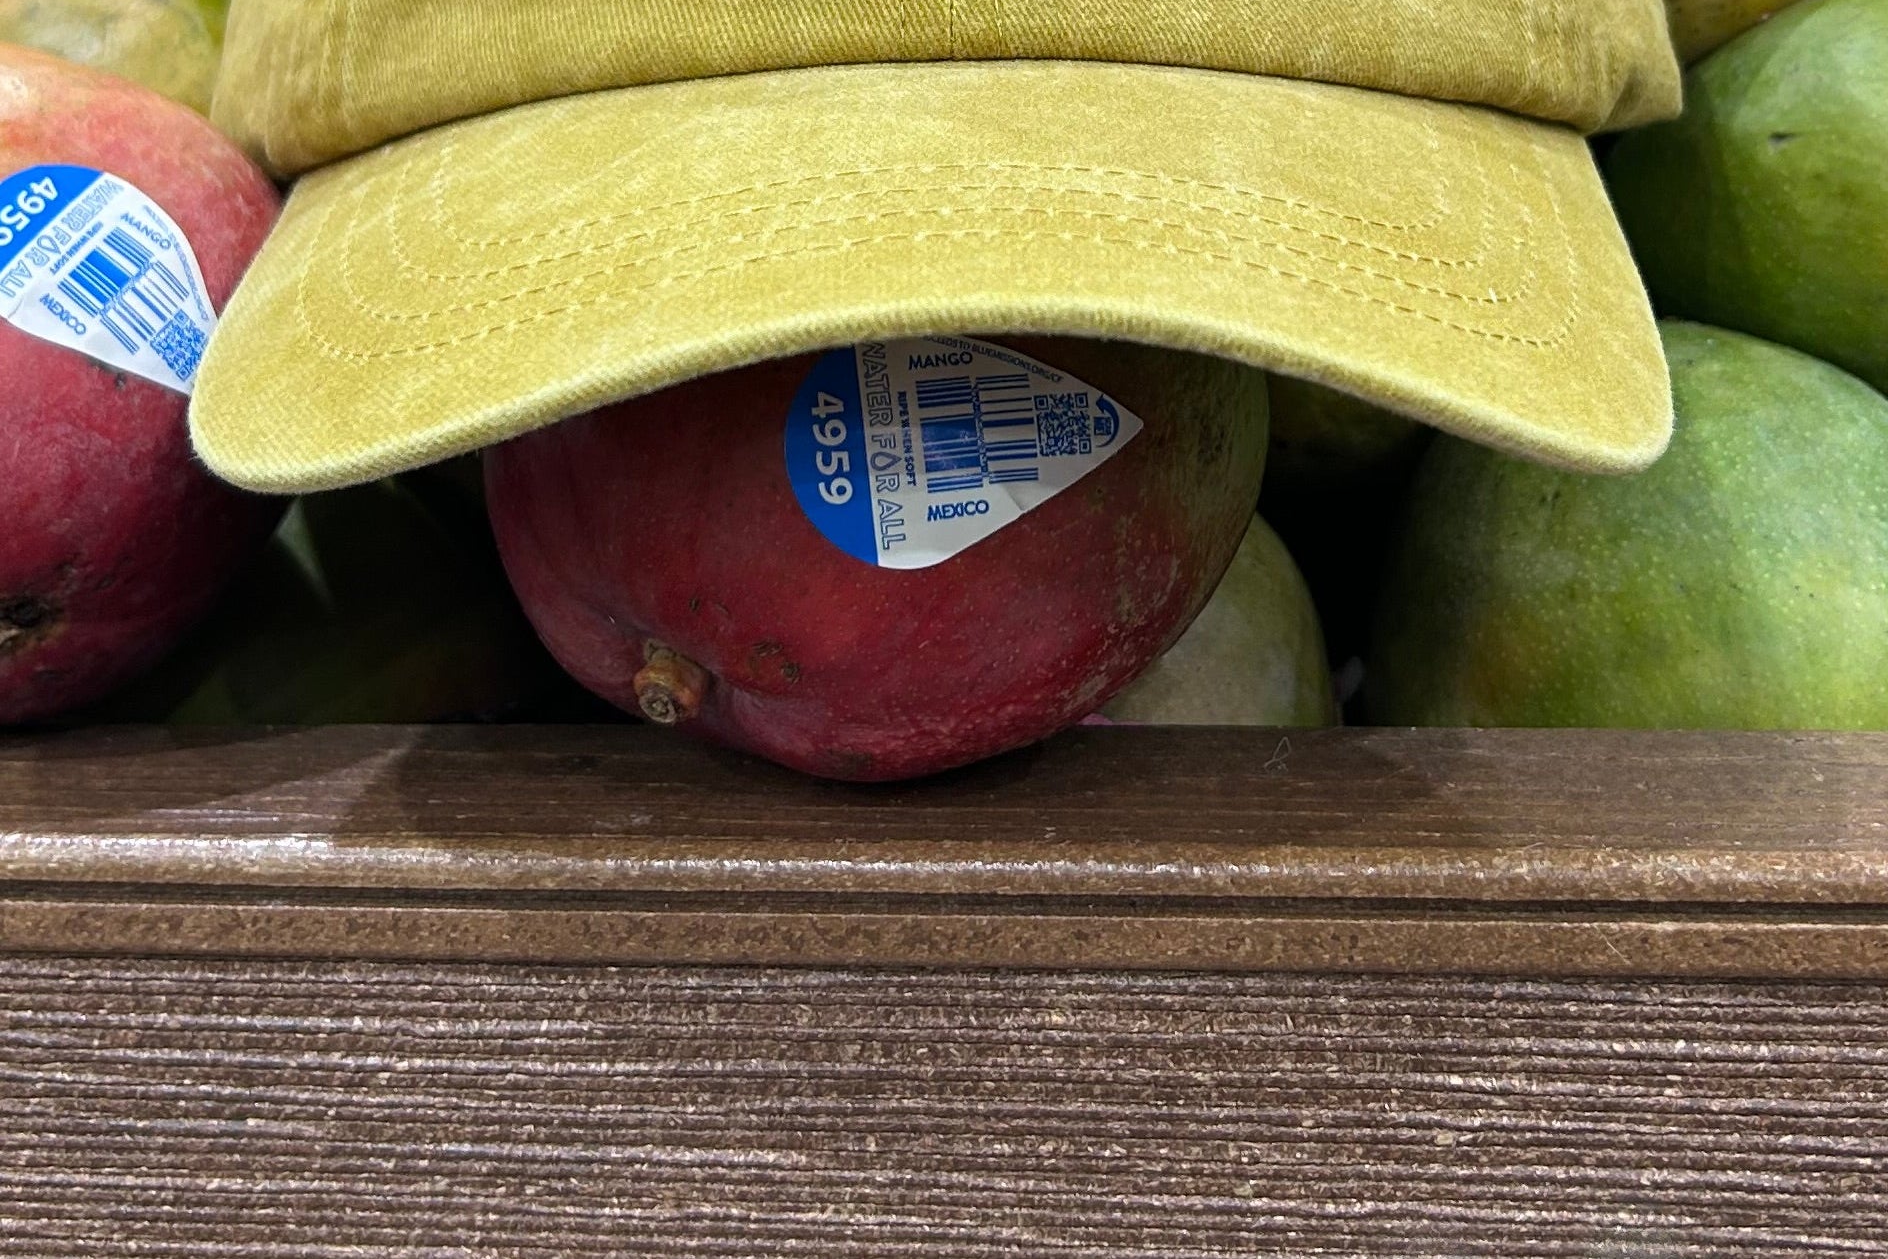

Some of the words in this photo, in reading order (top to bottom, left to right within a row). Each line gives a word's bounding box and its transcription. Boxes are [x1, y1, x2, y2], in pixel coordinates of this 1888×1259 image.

[61, 179, 124, 232] WATER
[120, 212, 171, 250] MANGO
[39, 293, 86, 335] MEXICO
[908, 351, 974, 371] MANGO
[862, 341, 893, 427] WATER
[897, 390, 909, 417] RIPE
[811, 391, 853, 505] 4959
[901, 417, 913, 453] WHEN
[869, 434, 902, 493] FOR
[904, 455, 917, 487] SOFT
[878, 499, 906, 550] ALL
[927, 499, 990, 522] MEXICO
